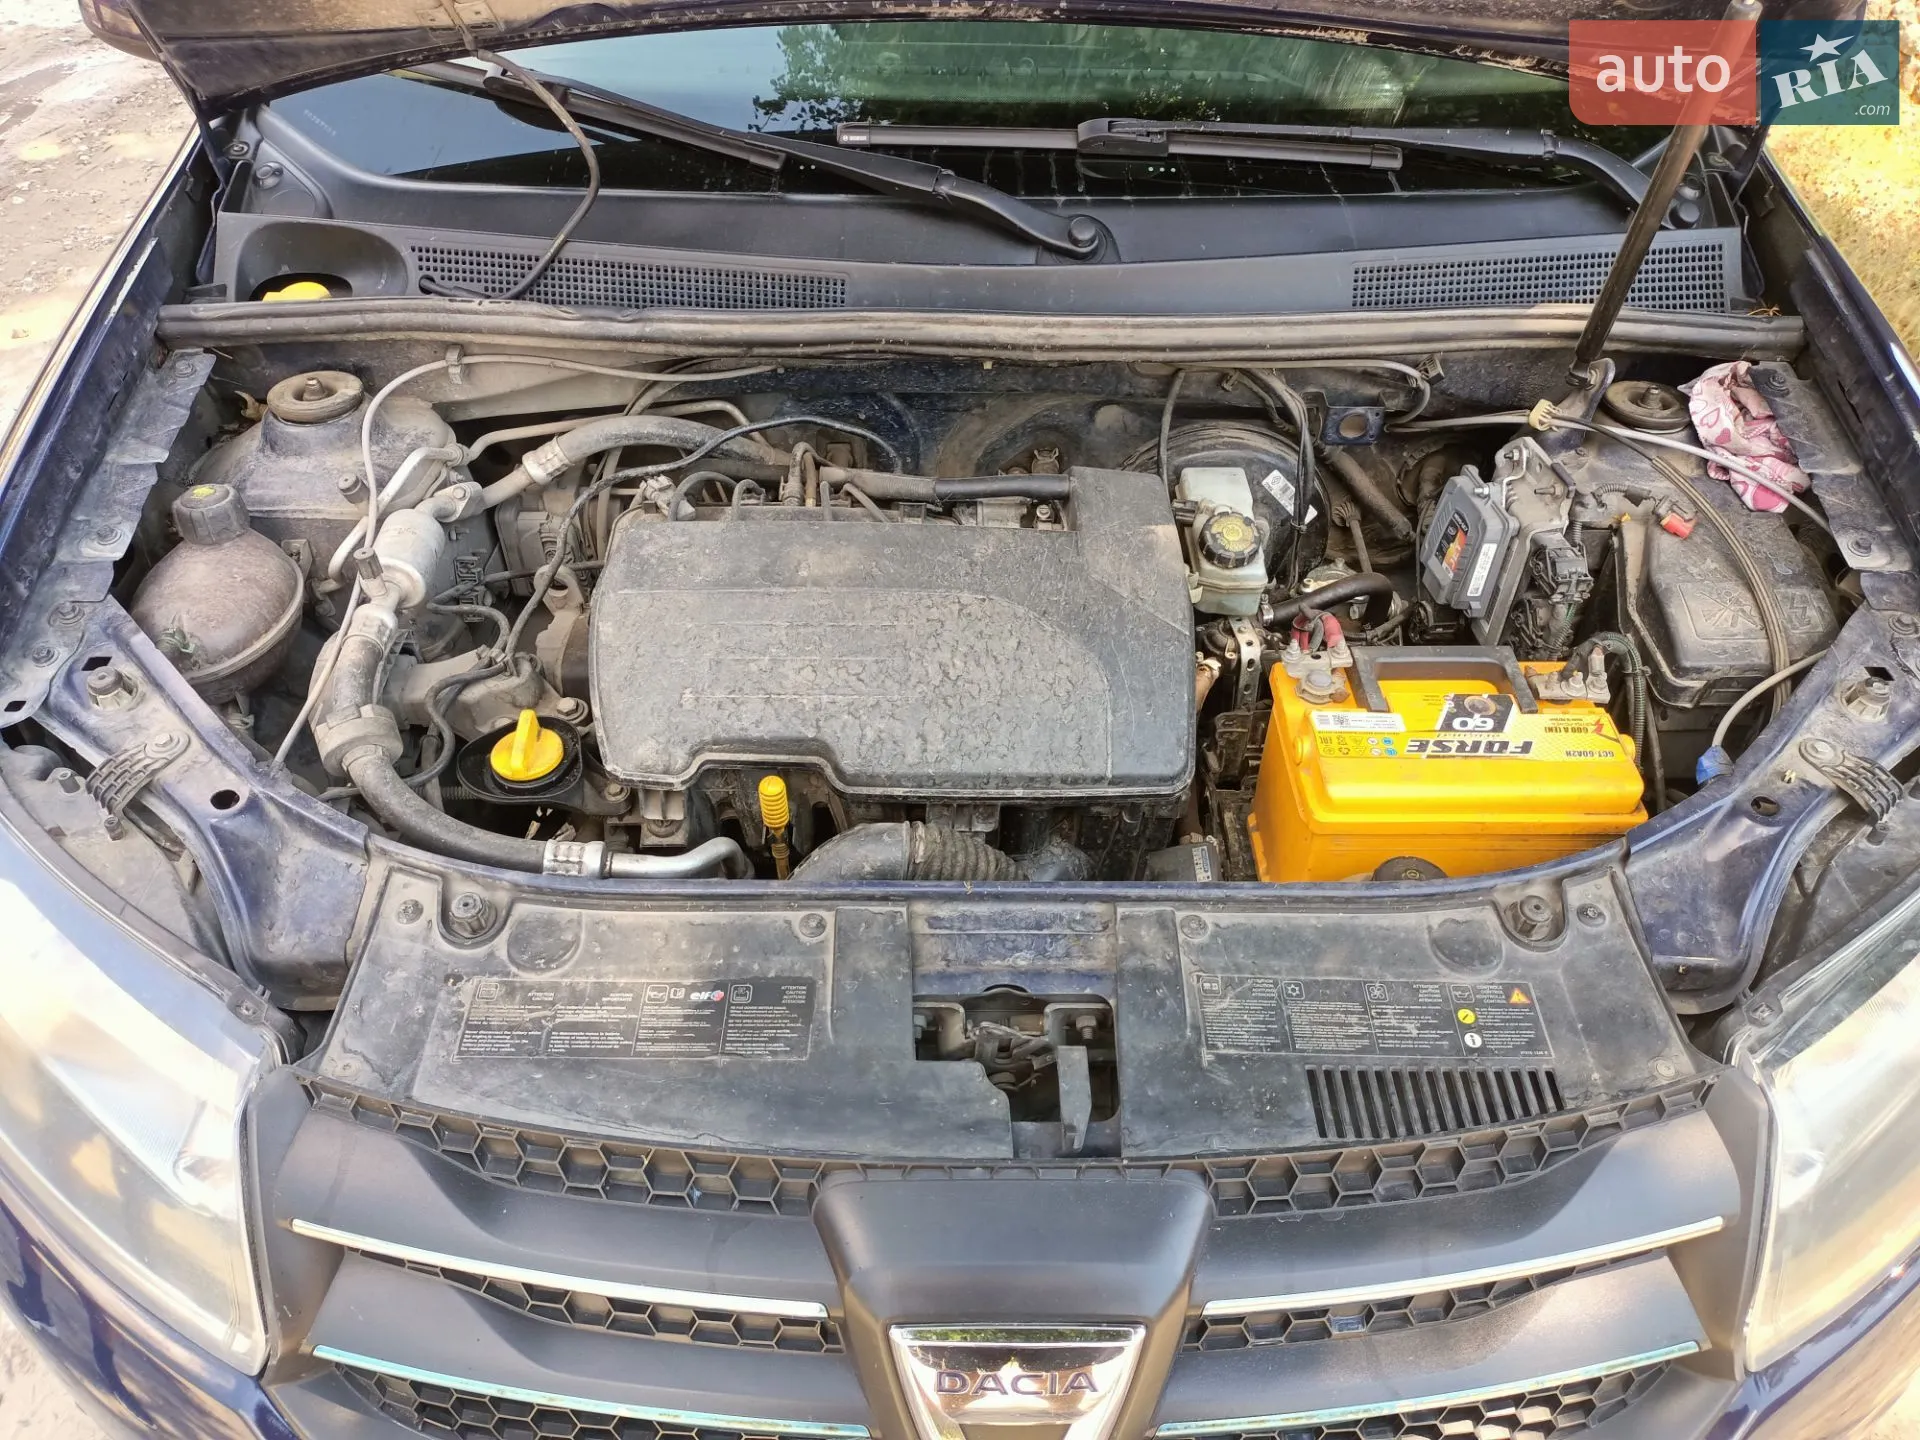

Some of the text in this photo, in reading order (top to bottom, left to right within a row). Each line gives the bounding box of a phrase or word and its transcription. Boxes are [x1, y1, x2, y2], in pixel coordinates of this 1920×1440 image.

[1452, 717, 1495, 731] 60
[1405, 739, 1534, 755] FORSE
[935, 1370, 1098, 1396] DACIA
